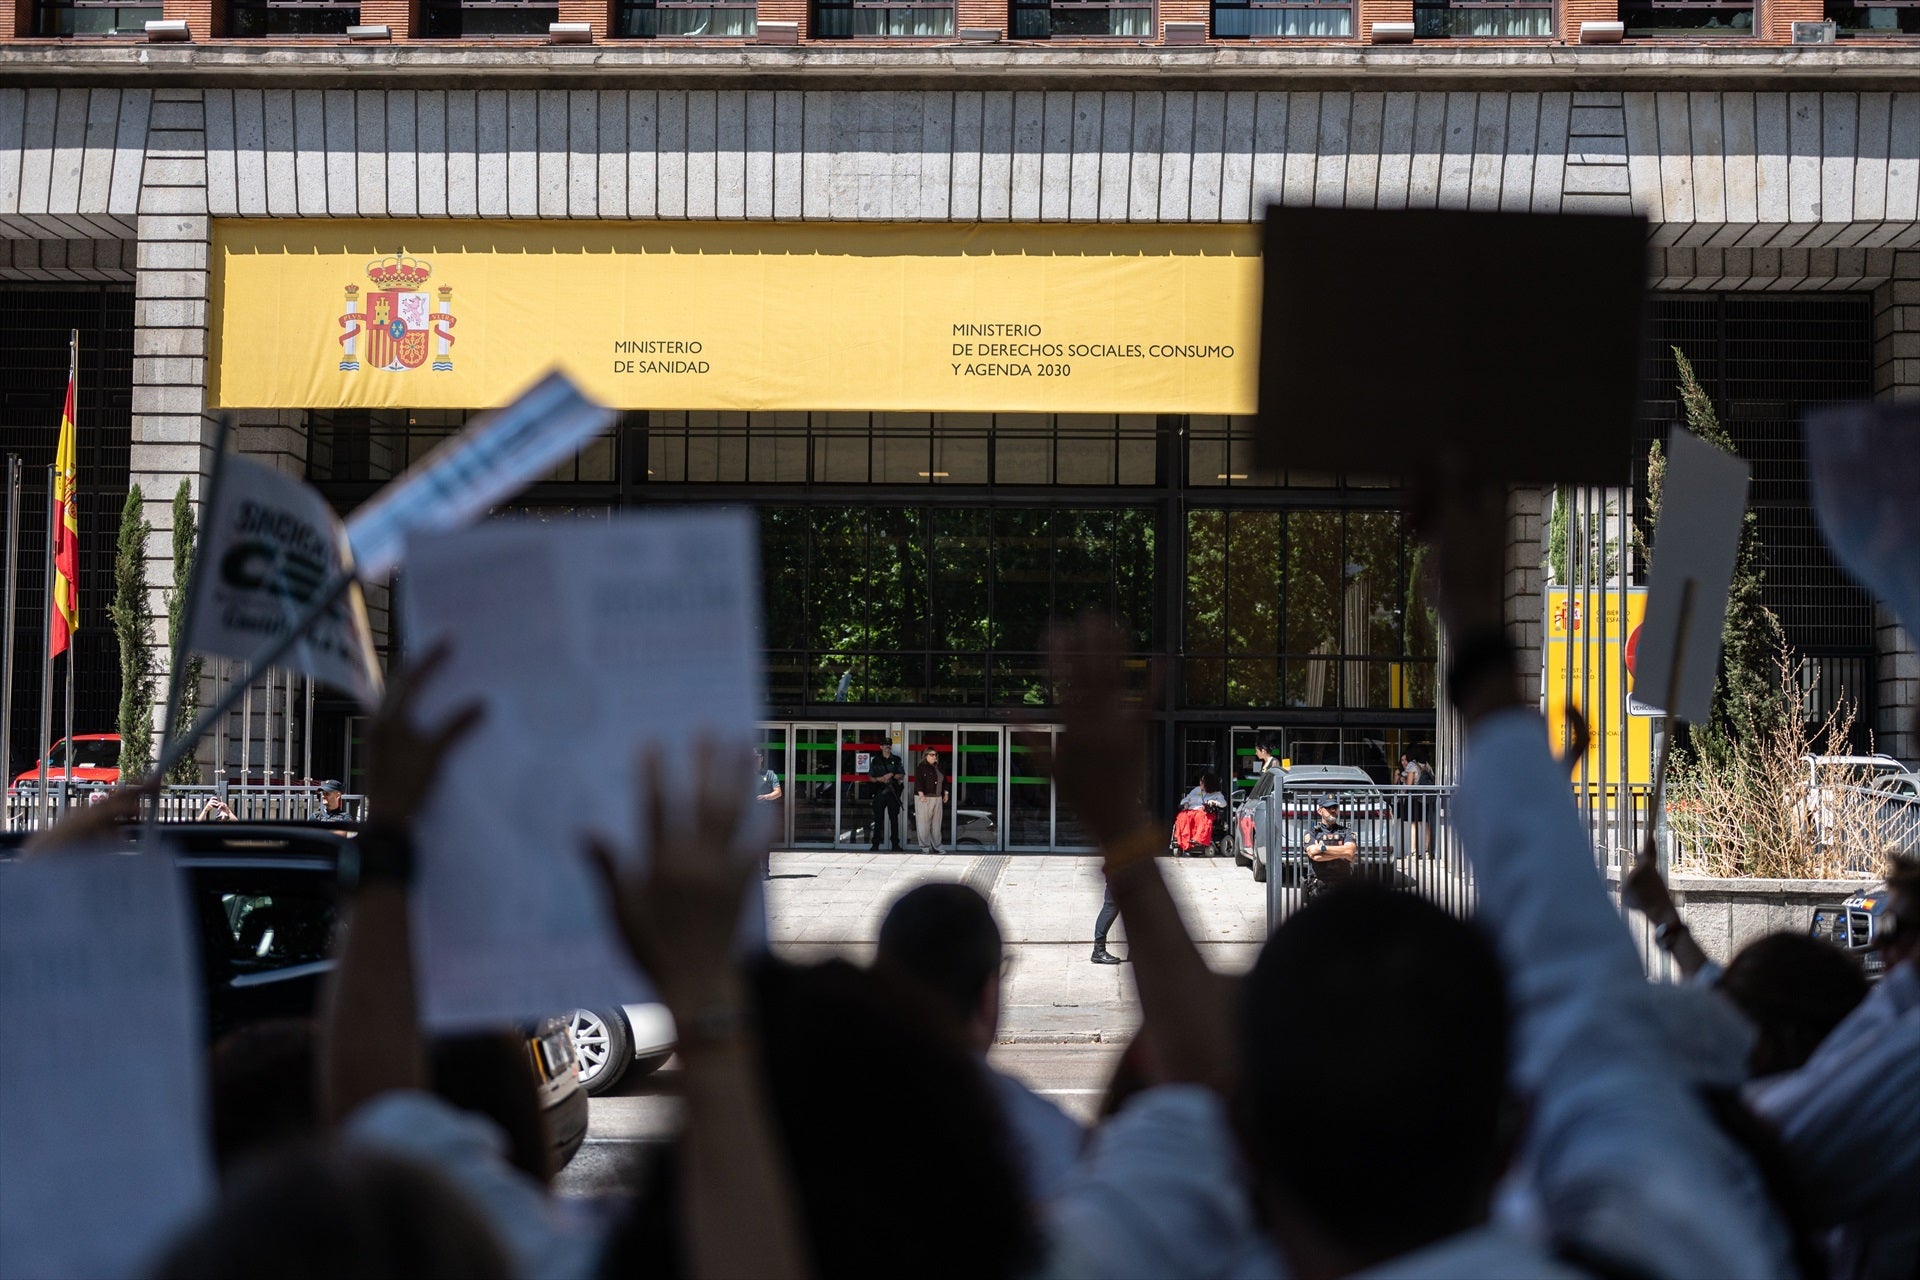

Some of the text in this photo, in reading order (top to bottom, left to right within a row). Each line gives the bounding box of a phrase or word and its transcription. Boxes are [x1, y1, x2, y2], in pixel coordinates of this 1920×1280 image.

[952, 323, 1042, 337] MINISTERIO
[614, 340, 703, 354] MINISTERIO
[952, 343, 1235, 359] DE DERECHOS SOCIALES, CONSUMO
[614, 360, 710, 374] DE SANIDAD
[951, 363, 1071, 377] Y AGENDA 2030
